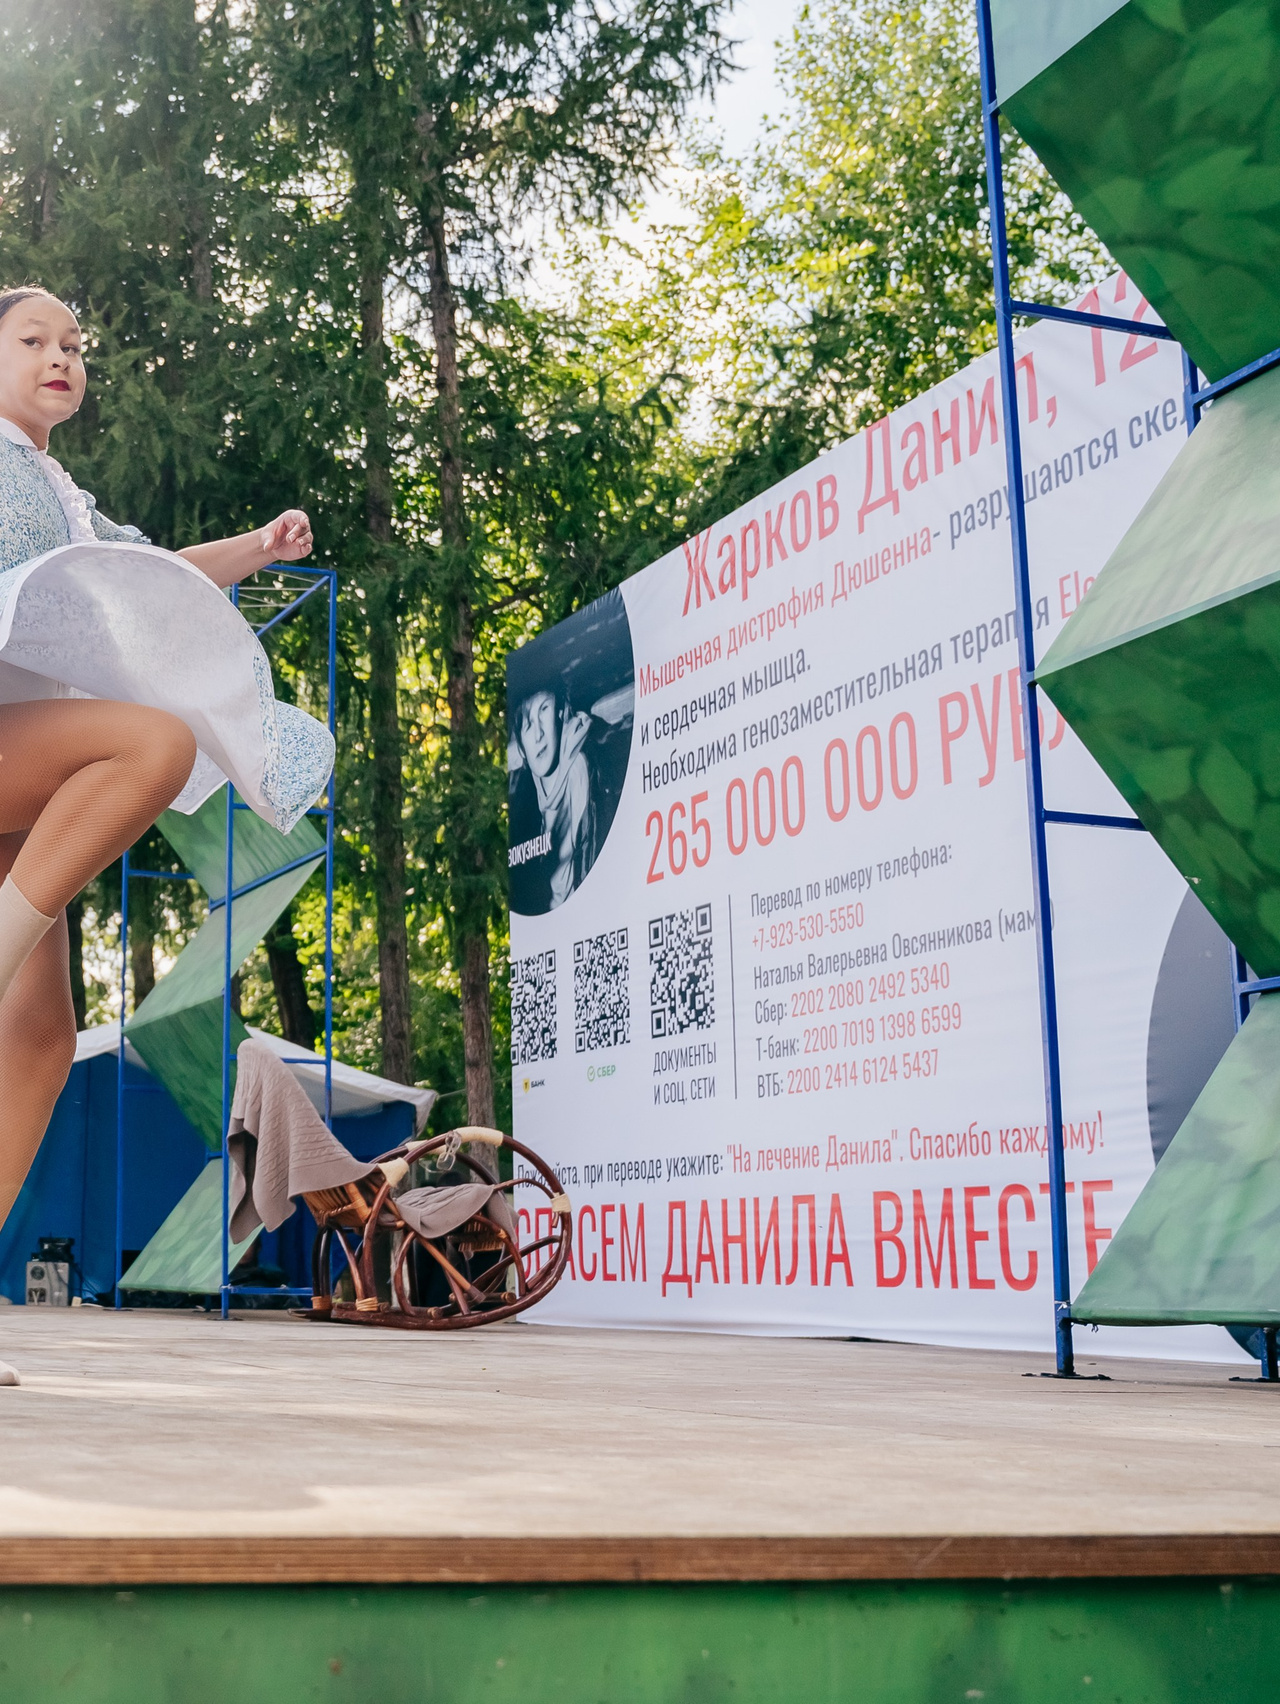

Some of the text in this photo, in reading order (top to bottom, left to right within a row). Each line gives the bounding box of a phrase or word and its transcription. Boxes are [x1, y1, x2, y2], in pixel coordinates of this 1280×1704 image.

[682, 473, 840, 618] Жарков
[640, 635, 722, 699] Мышечная
[726, 581, 825, 660] дистрофия
[831, 527, 941, 608] Дюшенна-
[640, 648, 811, 747] и сердечная мышца.
[642, 733, 738, 794] Необходима
[742, 641, 944, 753] генозаместительная
[949, 595, 1050, 664] терапя
[645, 666, 1066, 885] 265 000 000 РУБ
[751, 844, 953, 917] Перевод по номеру телефона:
[752, 902, 864, 952] +7-923-530-5550
[754, 898, 1055, 990] Наталья Валерьевна Овсянникова (мам)
[755, 961, 950, 1026] Сбер: 2202 2080 2492 5340
[653, 1042, 717, 1076] ДОКУМЕНТЫ
[756, 1002, 962, 1061] Т-банк: 2200 7019 1398 6599
[596, 1064, 616, 1078] СБЕР
[653, 1076, 716, 1105] И СОЦ. СЕТИ
[757, 1048, 939, 1099] ВТБ: 2200 2414 6124 5437
[517, 1162, 580, 1188] Пожайста,
[584, 1163, 603, 1189] при
[607, 1158, 662, 1187] переводе
[666, 1151, 724, 1182] укажите:
[726, 1143, 752, 1174] "На
[756, 1144, 820, 1173] лечение
[909, 1121, 992, 1161] Спасибо
[661, 1193, 854, 1298] ДАНИЛА
